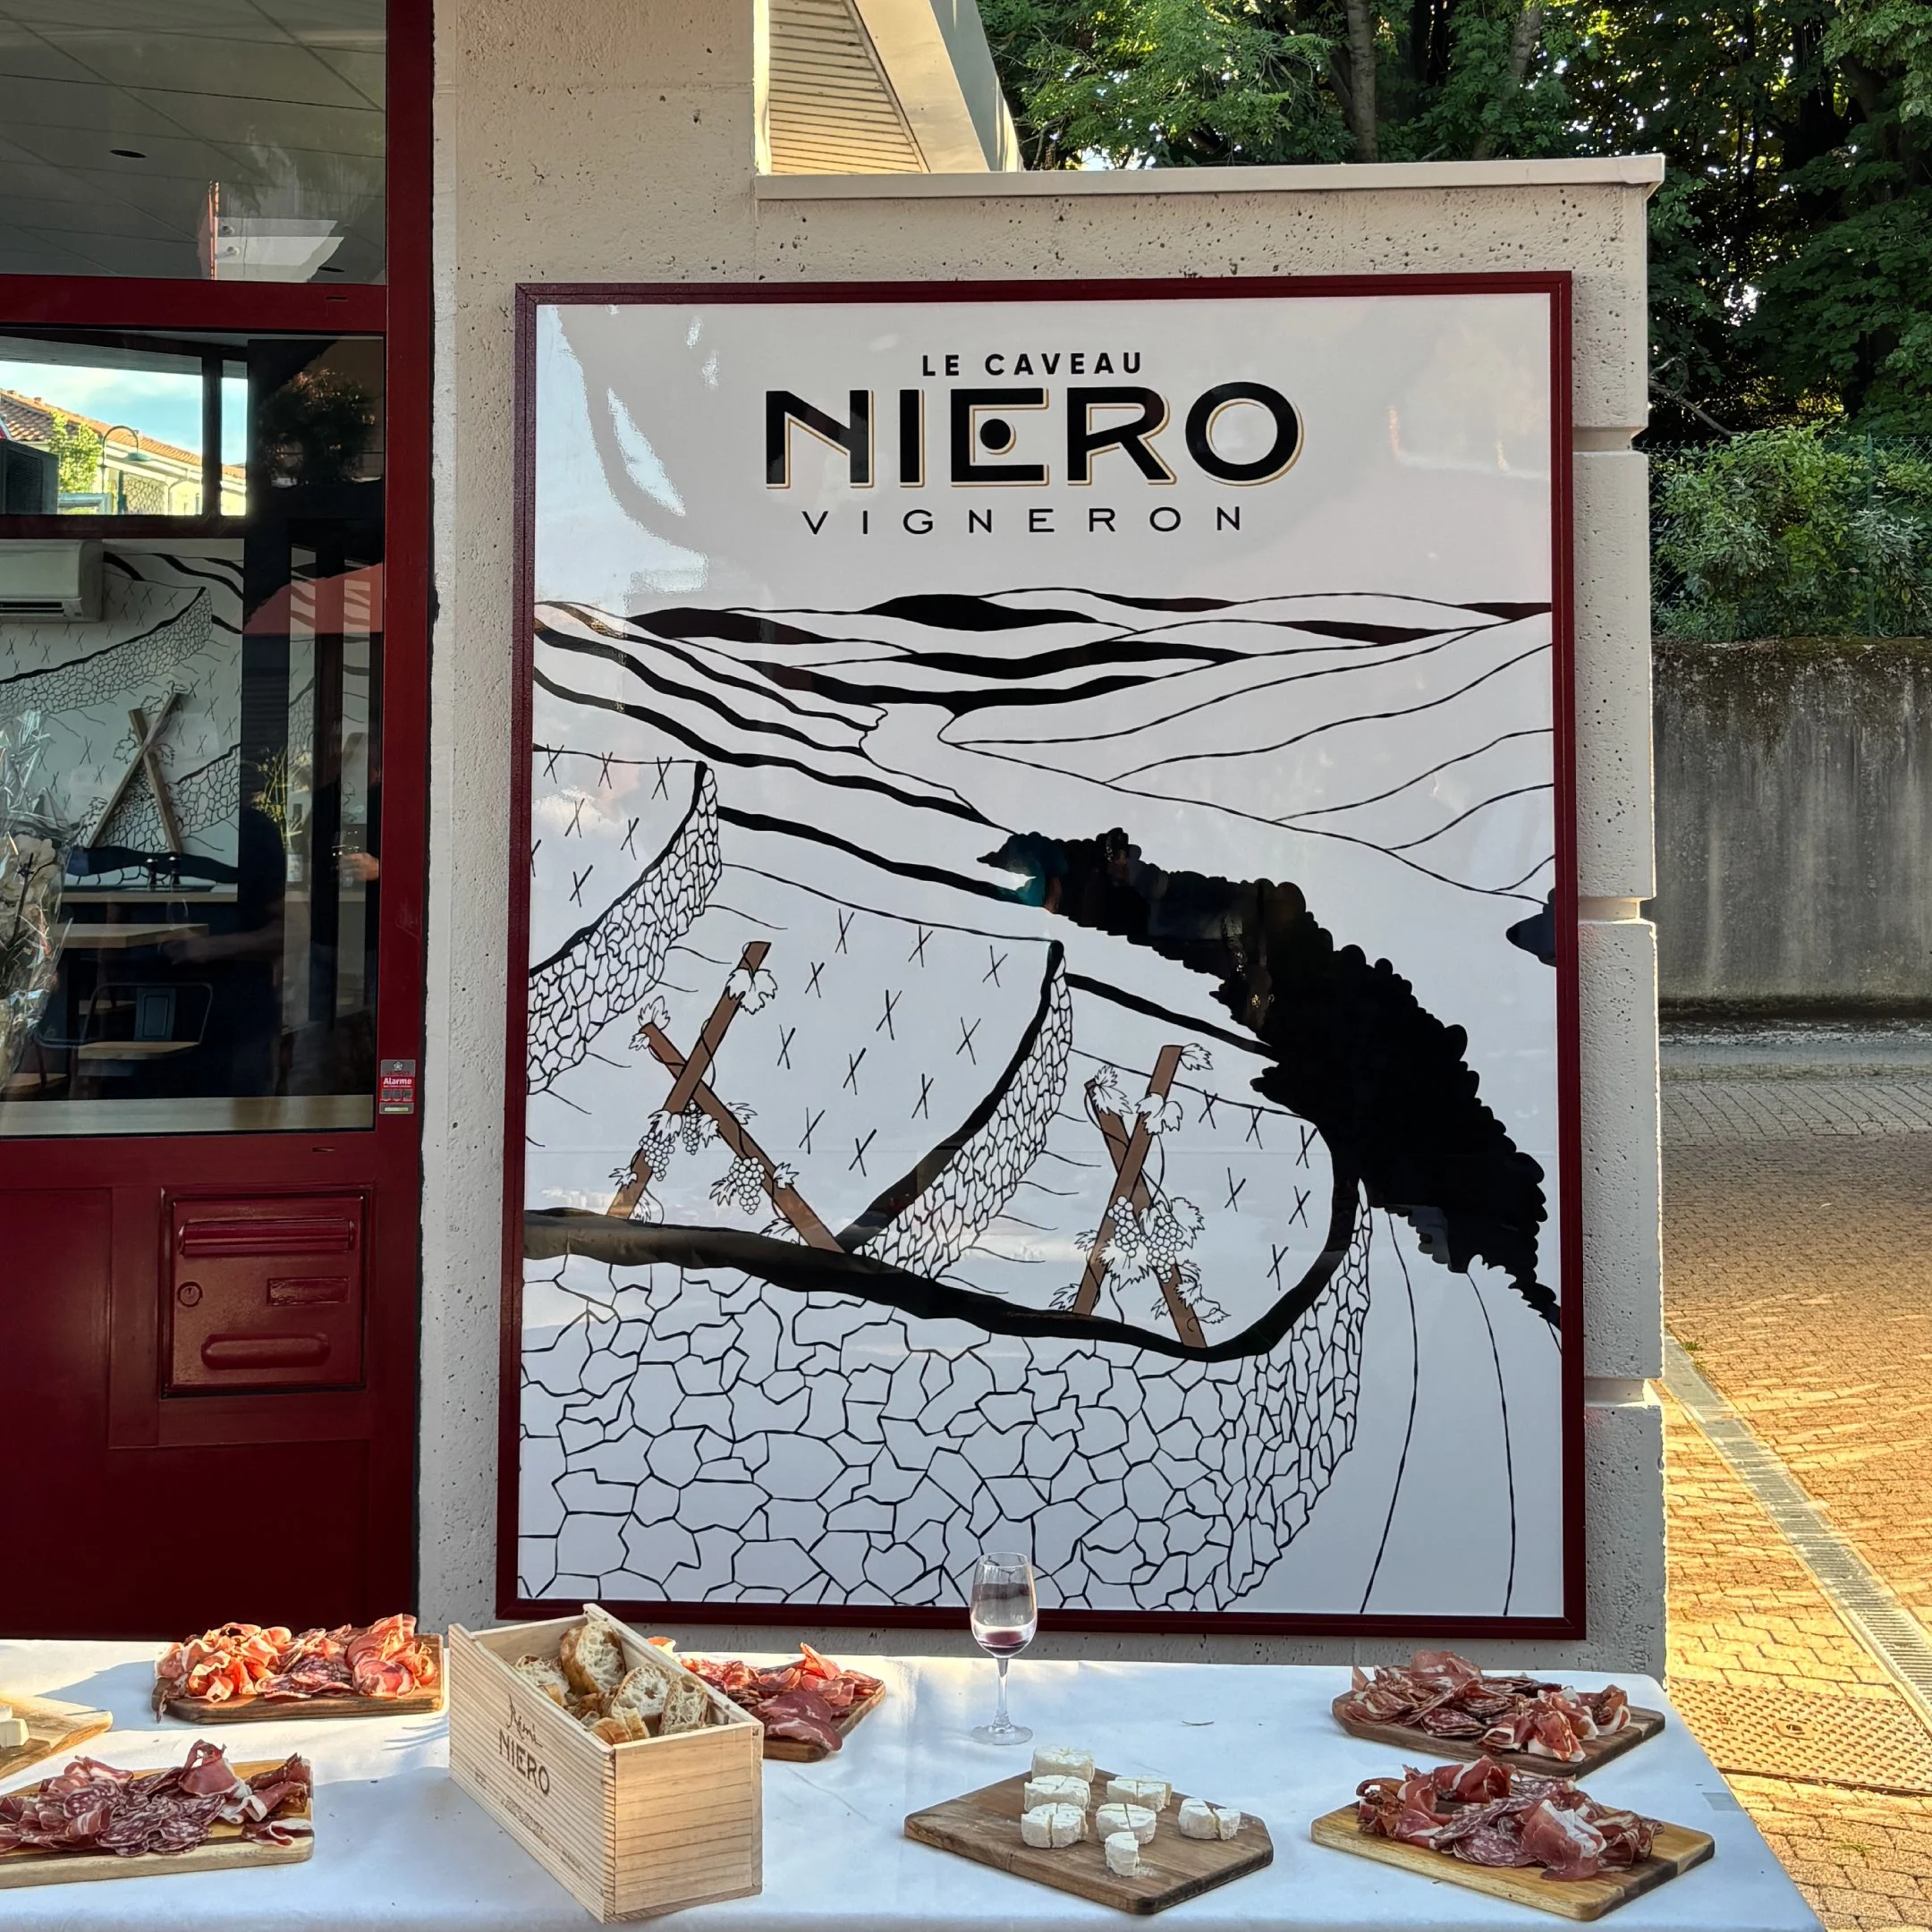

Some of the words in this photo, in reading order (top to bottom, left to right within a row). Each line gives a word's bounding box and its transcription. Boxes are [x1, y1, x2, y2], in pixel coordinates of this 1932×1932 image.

[922, 354, 959, 376] LE
[985, 352, 1142, 376] CAVEAU
[766, 381, 1303, 487] NIERO
[801, 505, 1241, 535] VIGNERON
[383, 1077, 412, 1085] Alarme
[498, 1728, 550, 1796] NIERO
